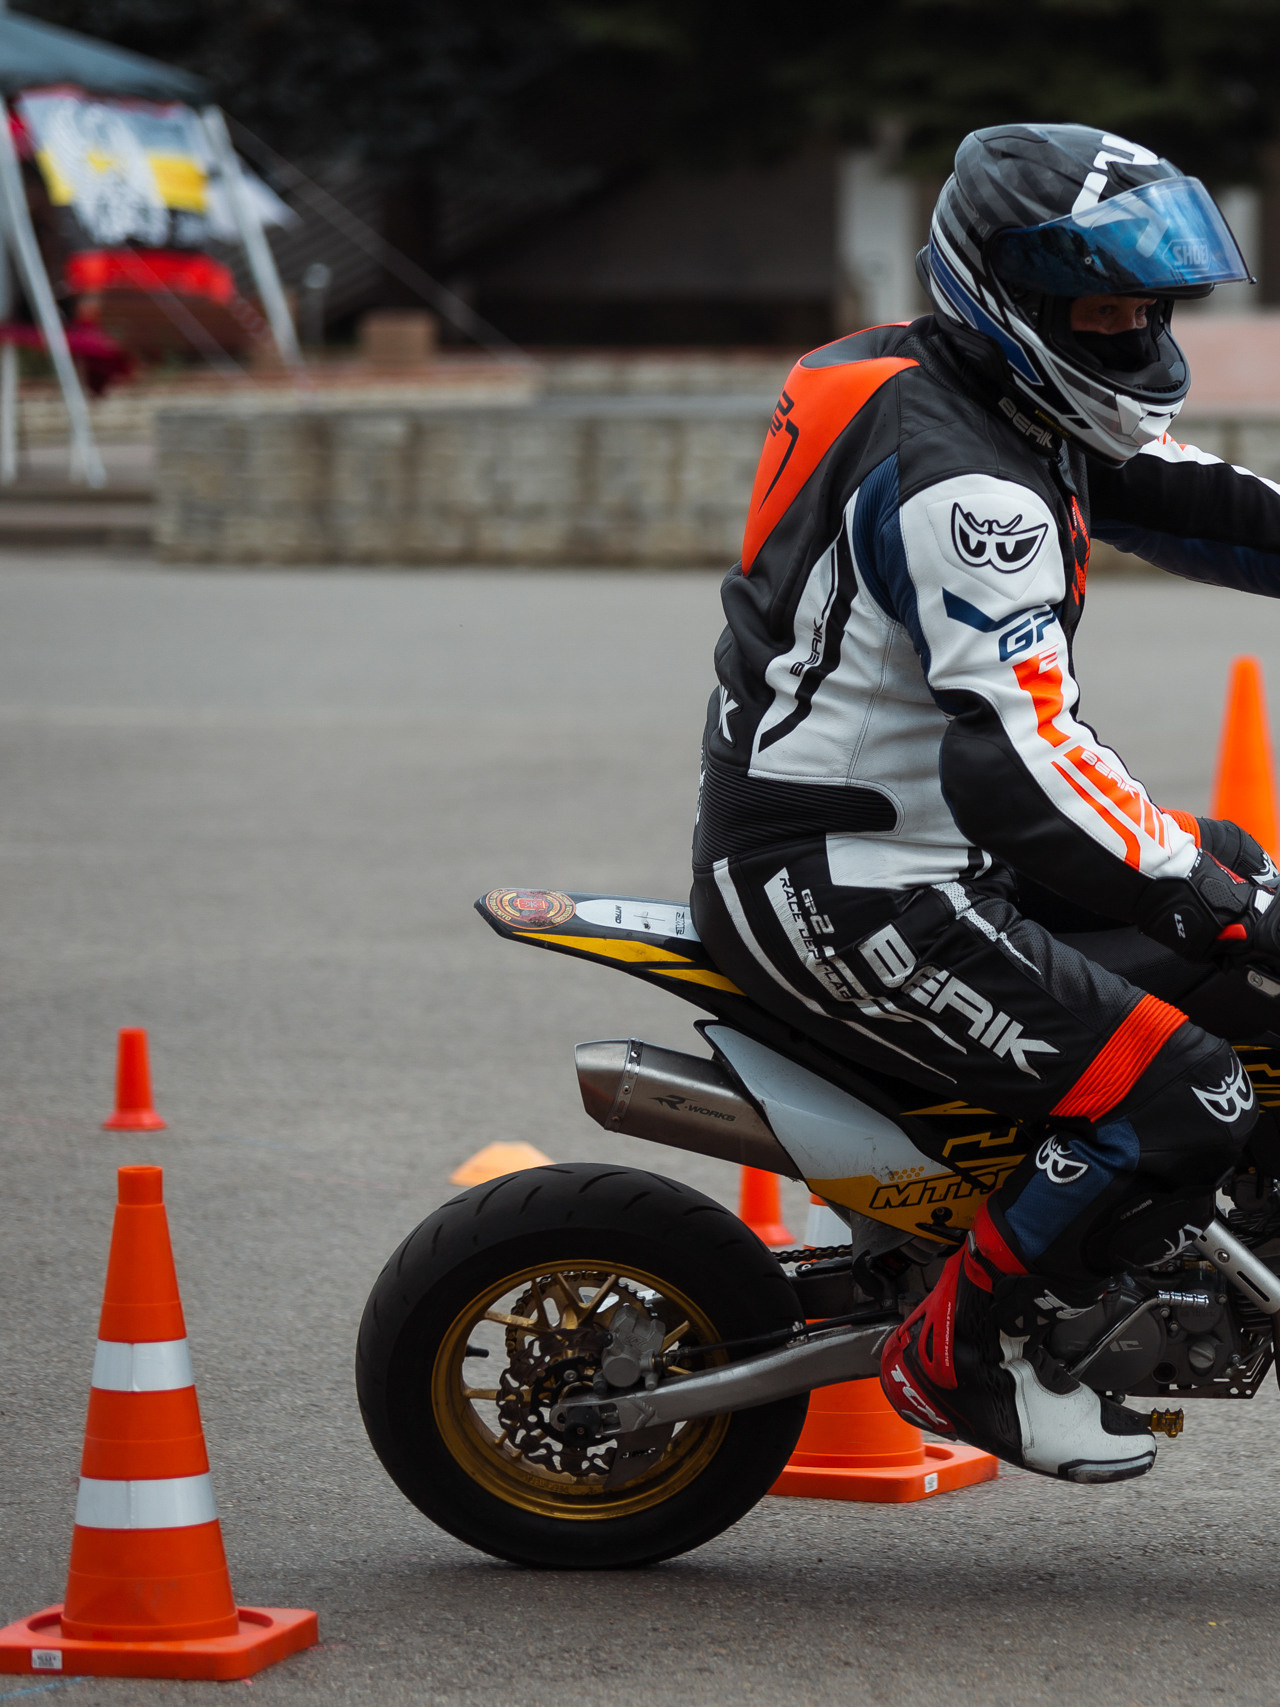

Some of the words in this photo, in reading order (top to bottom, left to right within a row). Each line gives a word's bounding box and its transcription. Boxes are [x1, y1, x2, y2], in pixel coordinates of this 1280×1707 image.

[998, 397, 1053, 448] BERIK
[789, 617, 824, 677] BERIK
[1080, 750, 1139, 799] BERIK
[780, 877, 804, 923] RACE
[857, 923, 1061, 1081] BERIK
[869, 1168, 1013, 1210] MTR
